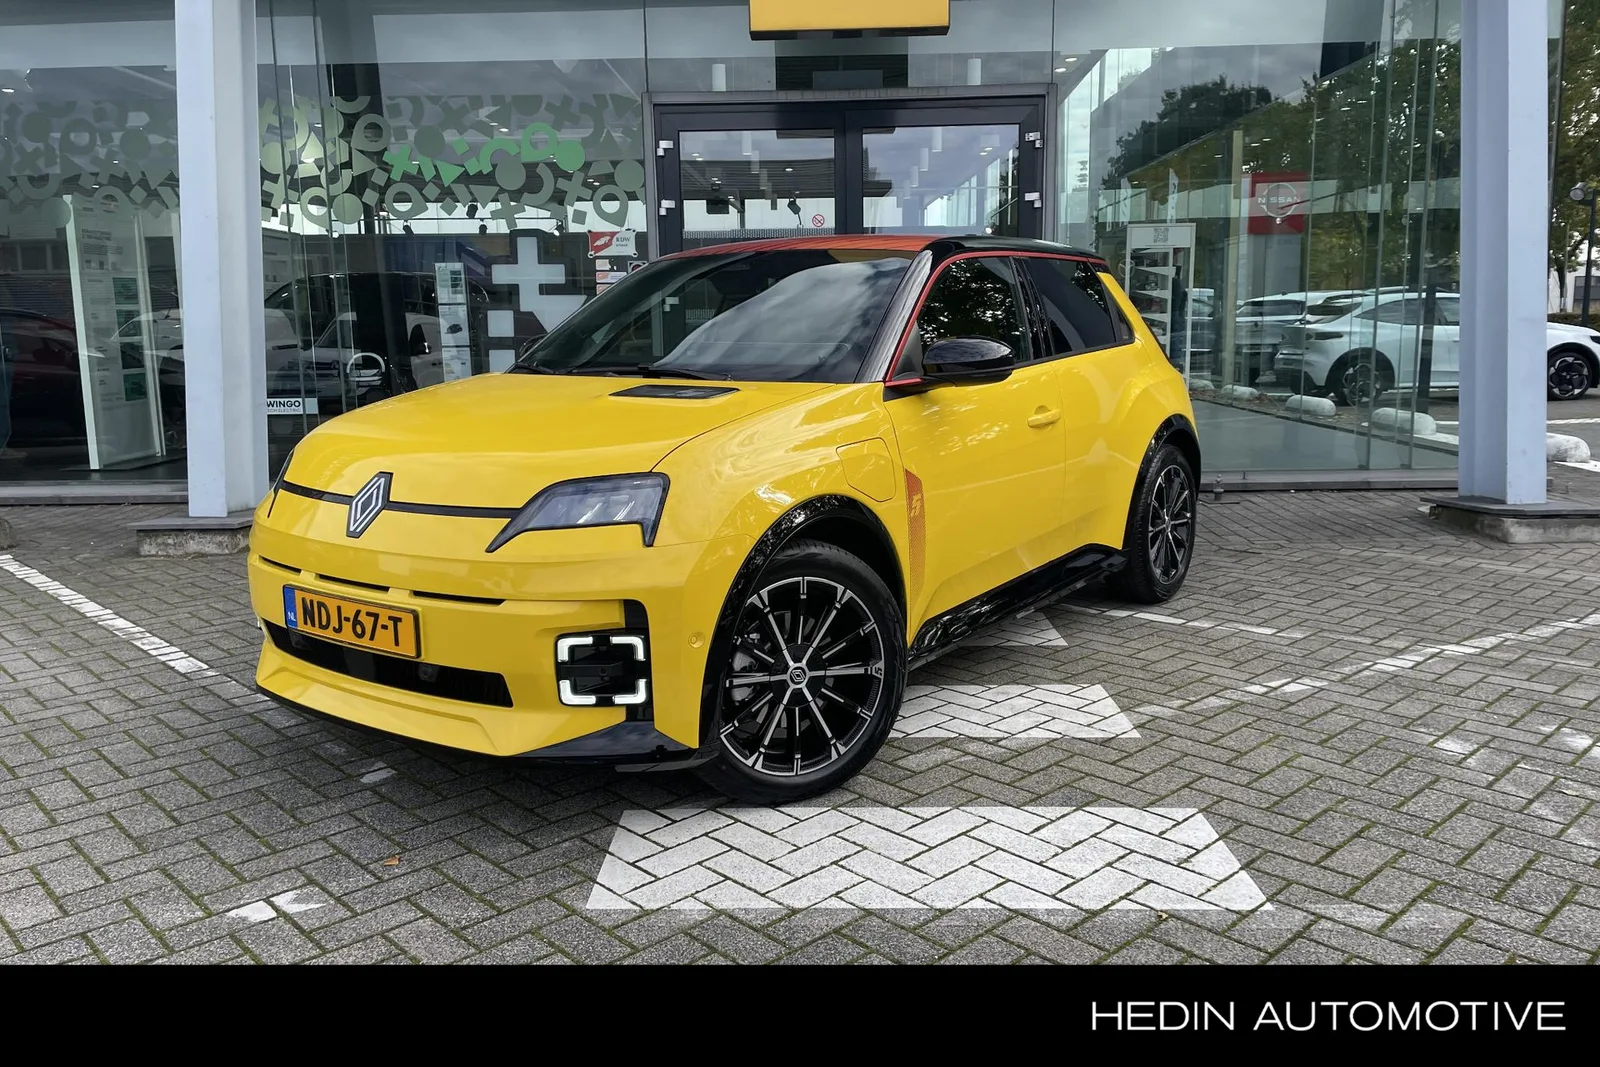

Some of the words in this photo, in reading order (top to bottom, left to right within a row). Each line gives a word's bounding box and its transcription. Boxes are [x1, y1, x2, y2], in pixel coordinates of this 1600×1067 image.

[266, 400, 301, 408] WINGO
[287, 611, 297, 622] NL
[301, 596, 403, 647] NDJ-67-T
